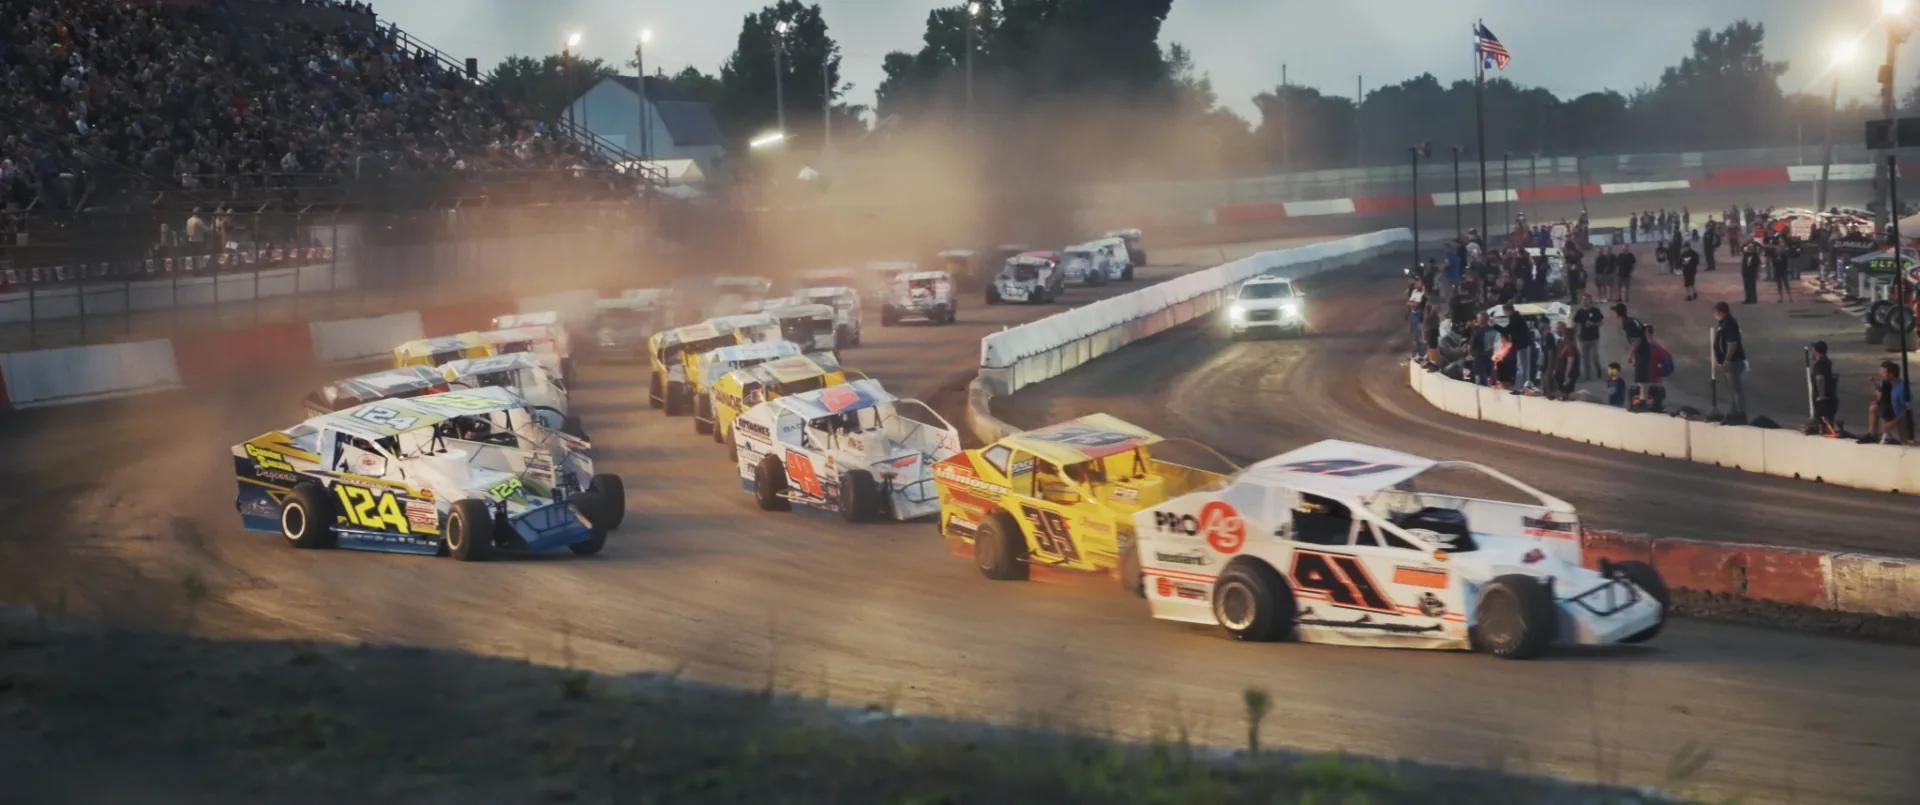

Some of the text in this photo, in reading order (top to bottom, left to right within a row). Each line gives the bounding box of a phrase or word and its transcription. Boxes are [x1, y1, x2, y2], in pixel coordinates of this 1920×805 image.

[352, 405, 418, 430] 124
[490, 474, 522, 498] 124
[334, 483, 409, 534] 124
[1154, 511, 1200, 536] PRO
[1290, 549, 1396, 613] 41
